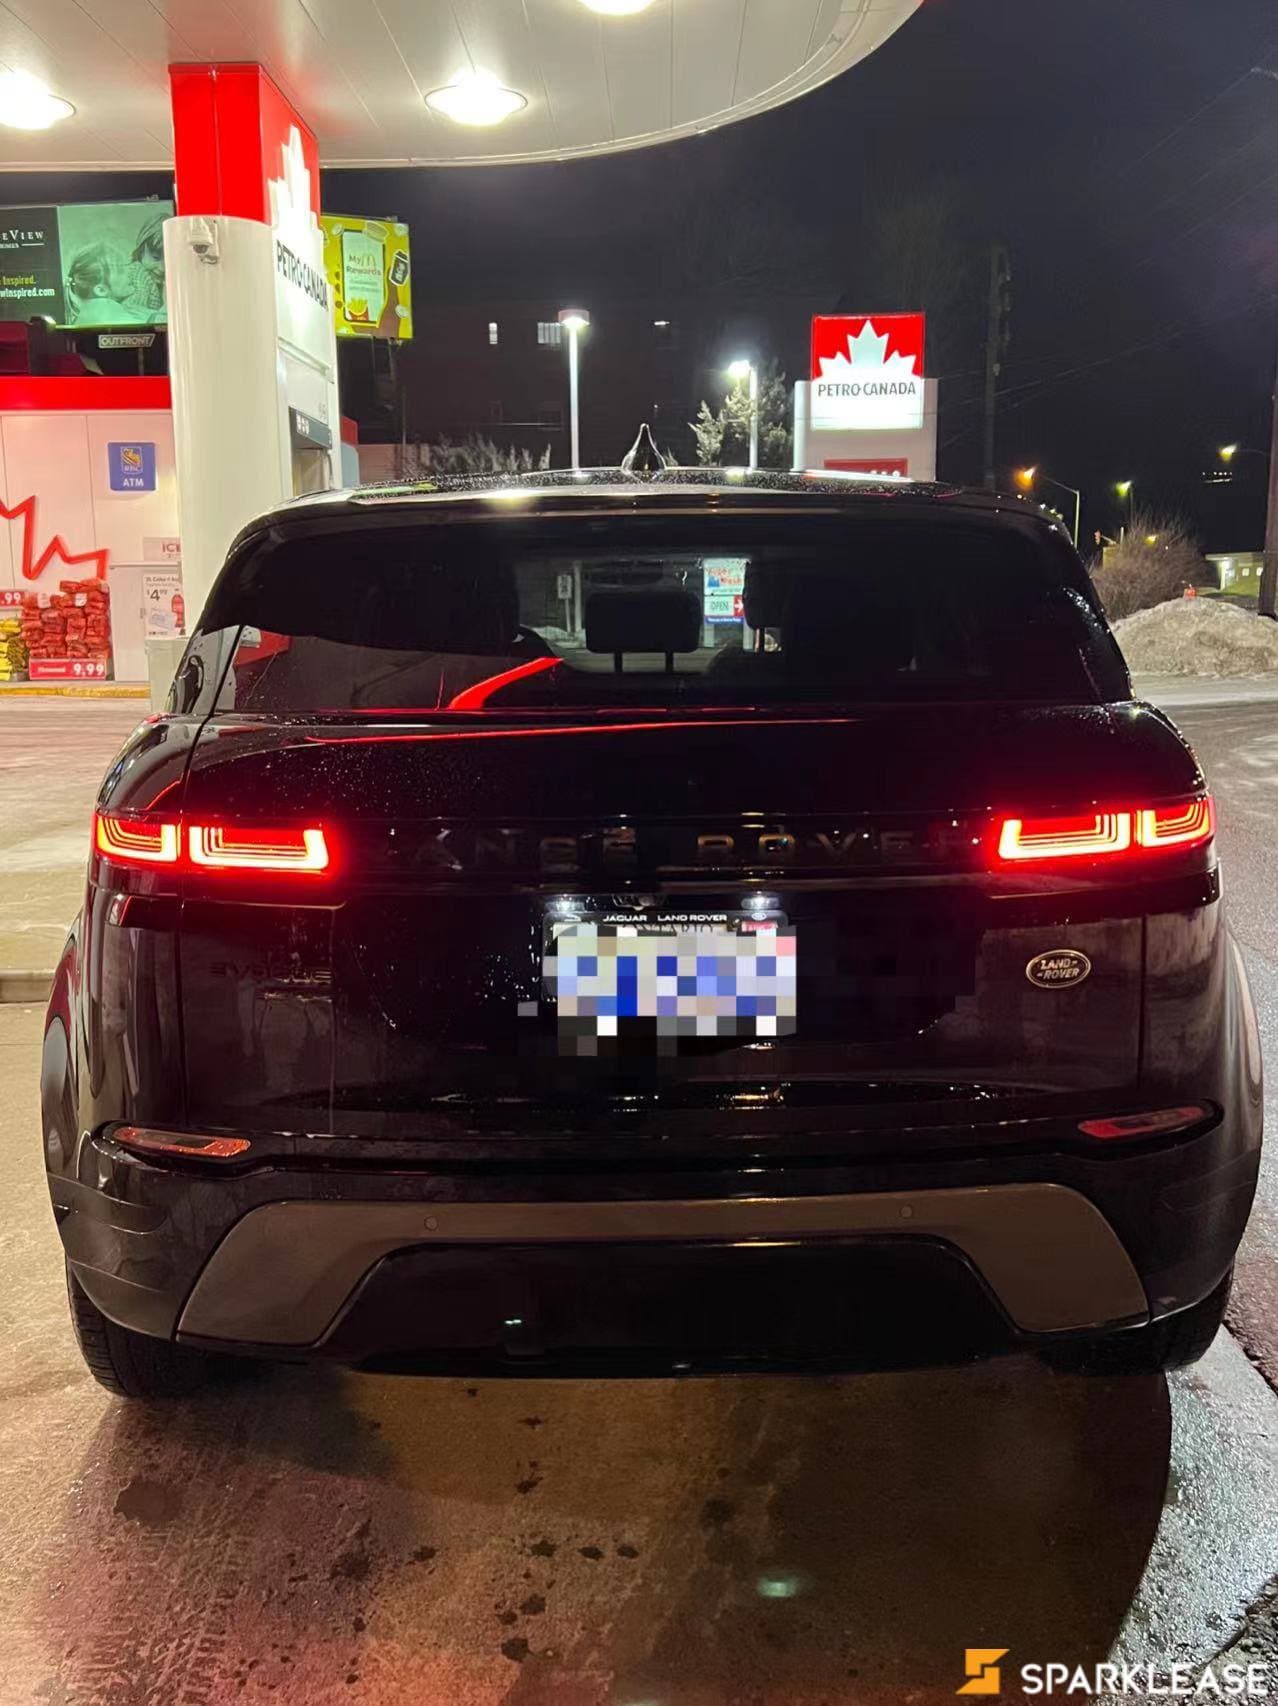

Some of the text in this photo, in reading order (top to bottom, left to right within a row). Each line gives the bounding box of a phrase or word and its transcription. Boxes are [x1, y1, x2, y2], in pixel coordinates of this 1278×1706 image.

[101, 336, 150, 346] OUTFRONT
[123, 478, 144, 487] ATM
[73, 663, 104, 676] 9.99
[602, 914, 648, 922] JAGUAR
[657, 914, 688, 922] LAND
